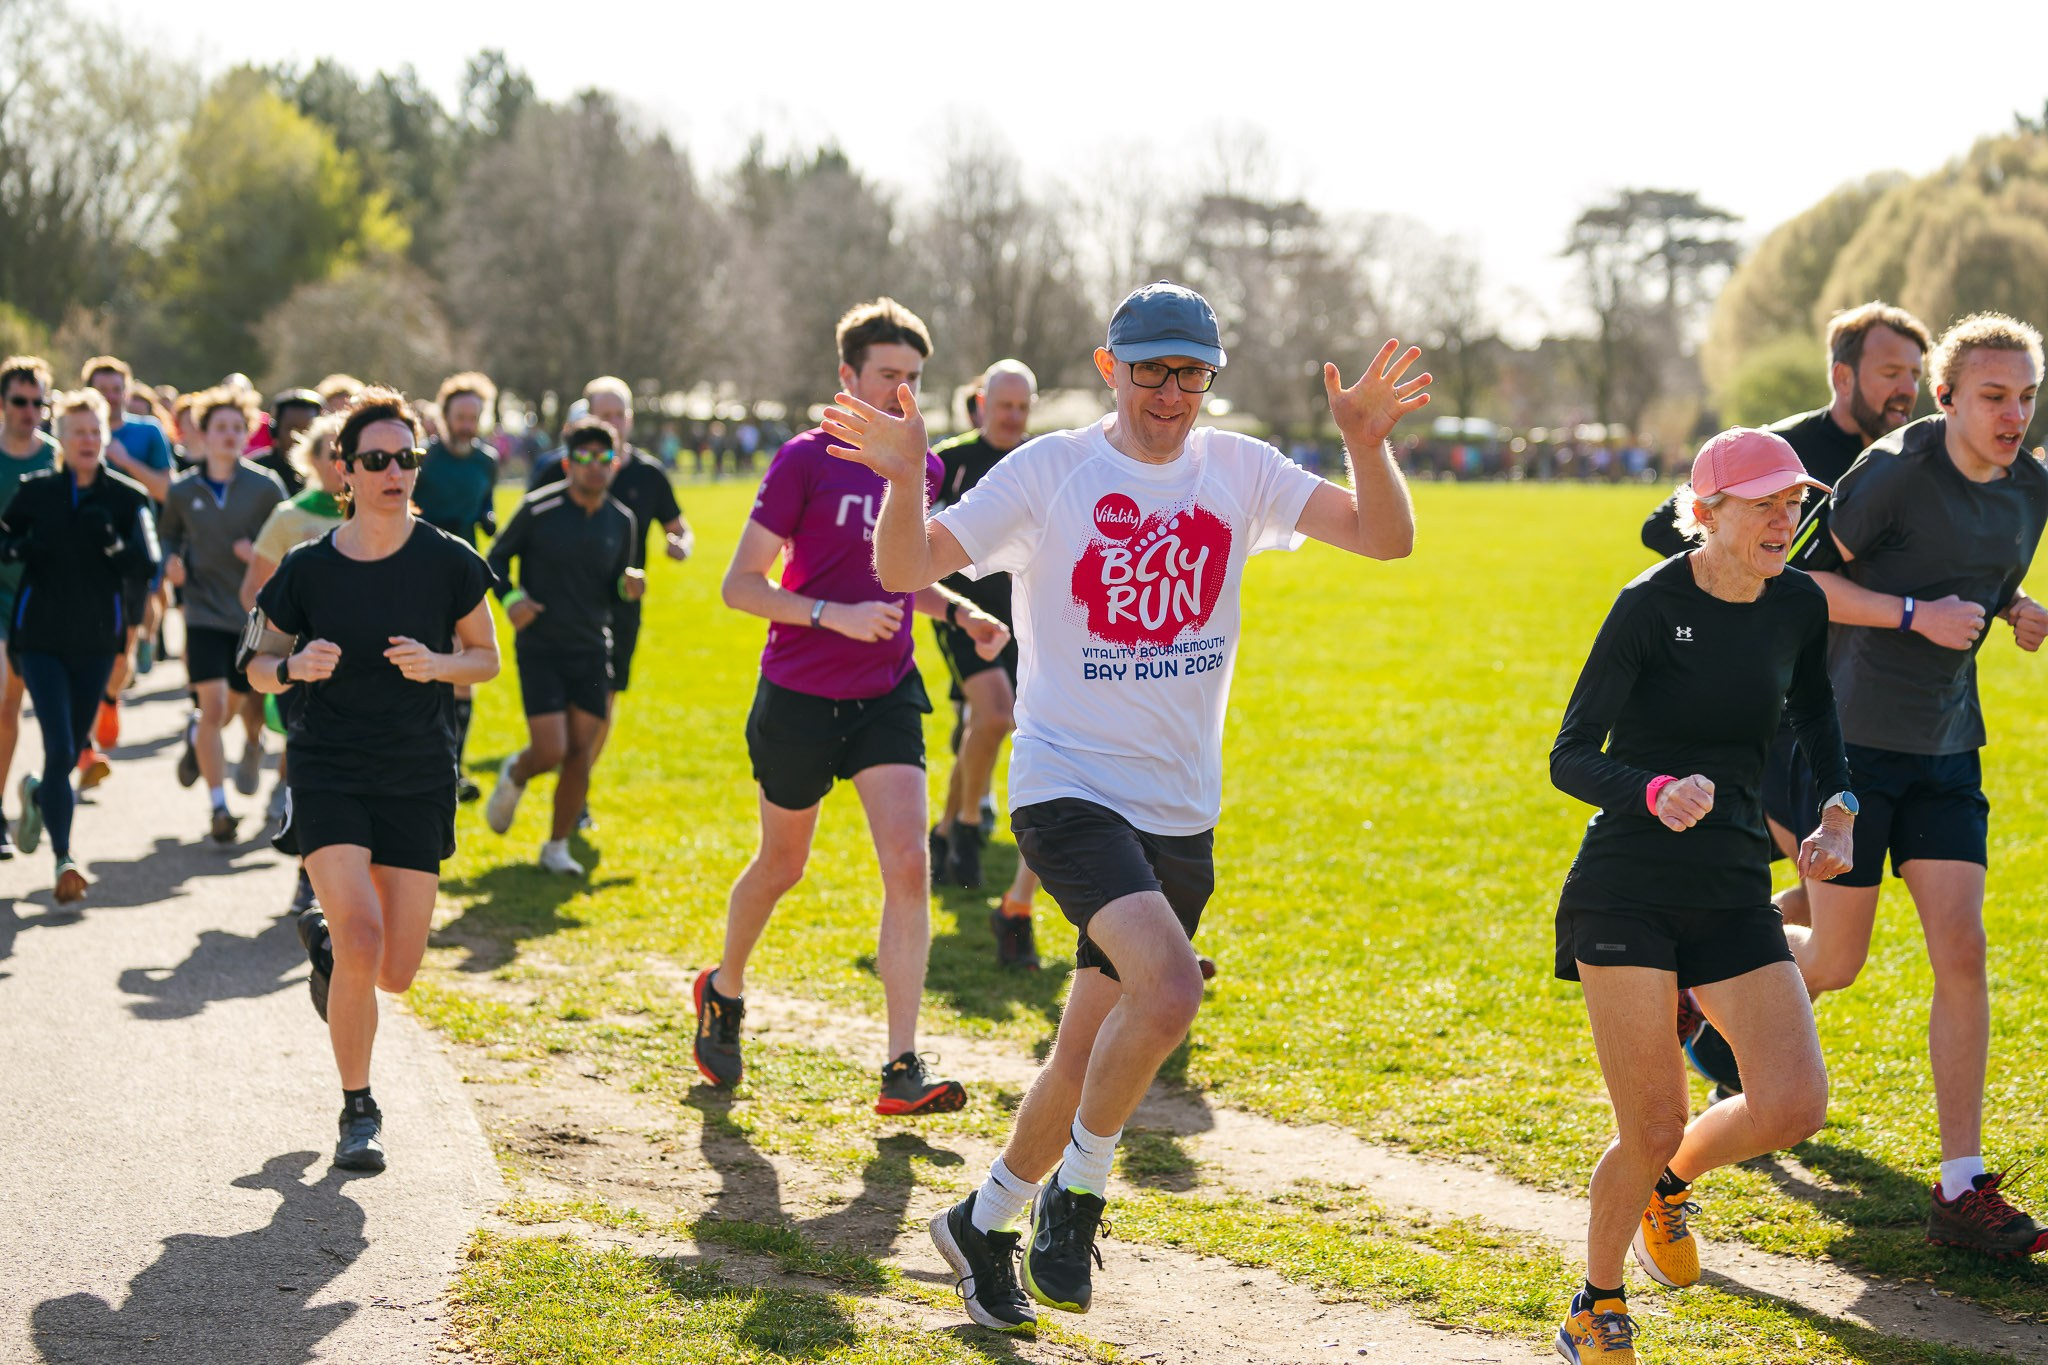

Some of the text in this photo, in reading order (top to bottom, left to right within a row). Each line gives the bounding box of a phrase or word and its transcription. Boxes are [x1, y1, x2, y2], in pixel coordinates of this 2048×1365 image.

[1094, 503, 1140, 530] Vitality
[1106, 577, 1201, 630] RUN
[1082, 636, 1226, 660] VITALITY BOURNEMOUTH
[1083, 651, 1224, 681] BAY RUN 2026
